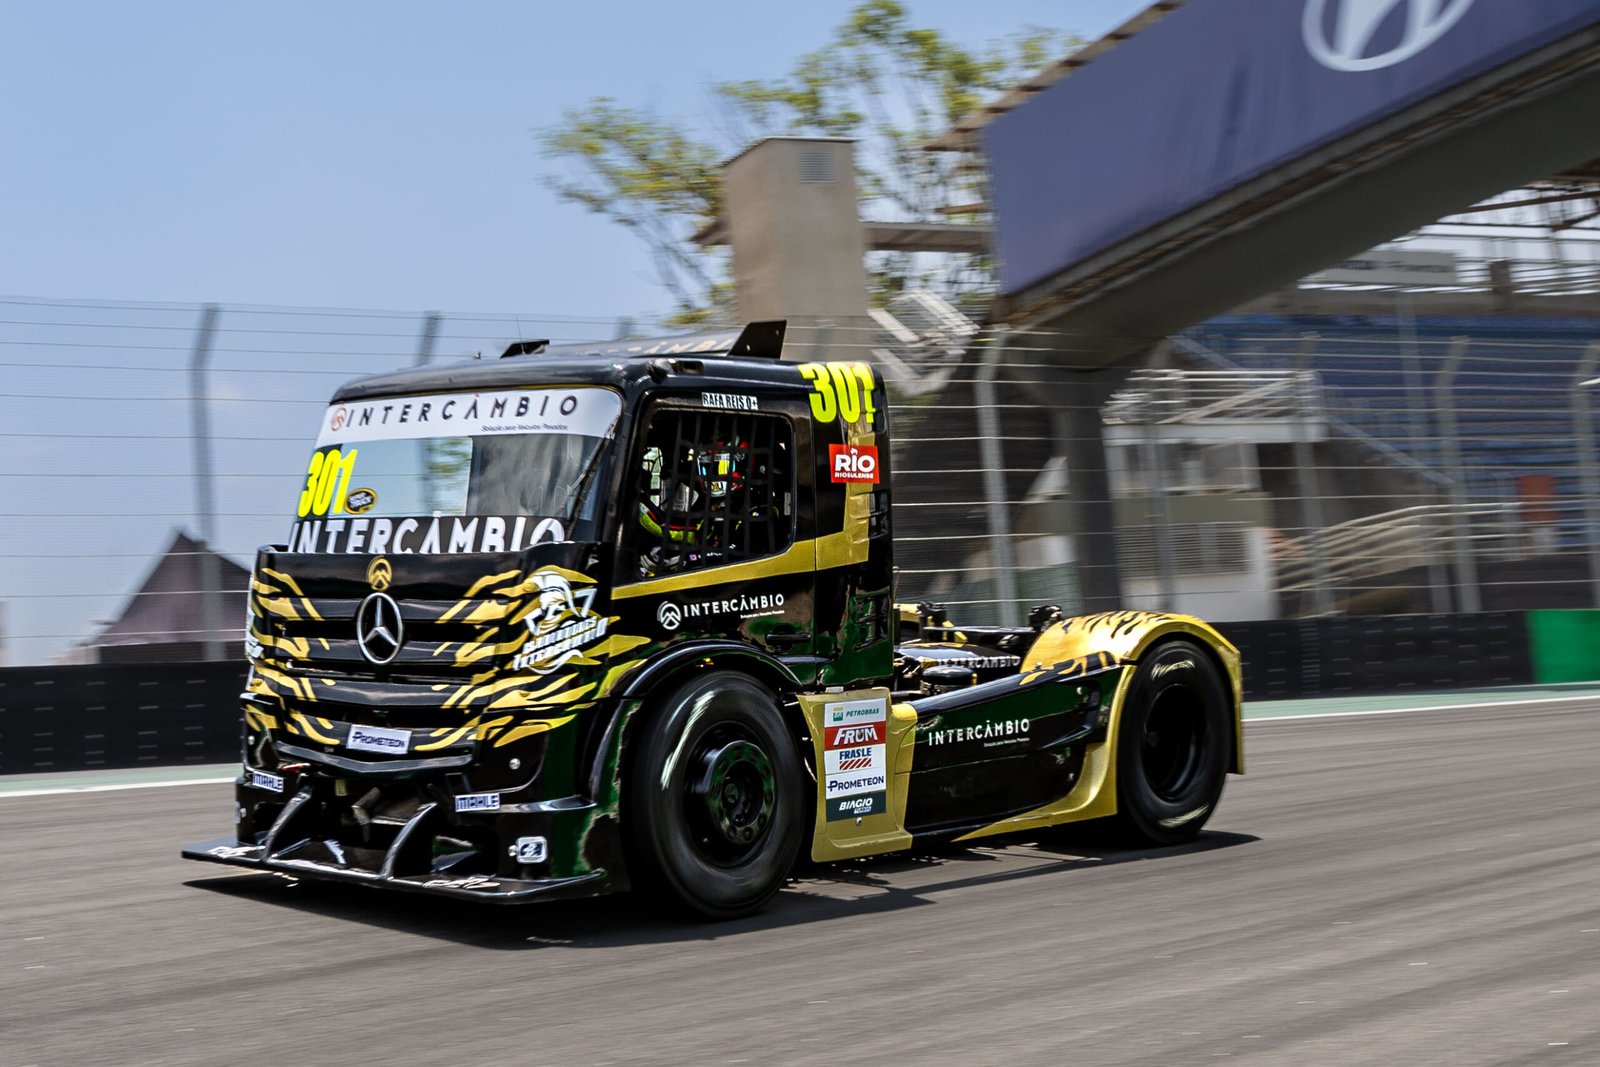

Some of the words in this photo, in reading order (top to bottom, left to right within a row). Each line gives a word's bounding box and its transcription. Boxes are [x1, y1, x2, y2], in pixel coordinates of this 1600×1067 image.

[703, 393, 724, 407] RAFA
[726, 395, 744, 409] REIS
[798, 362, 875, 423] 301
[346, 392, 577, 427] INTERCÂMBIO
[298, 449, 358, 517] 301
[684, 594, 784, 617] INTERCÂMBIO
[846, 708, 880, 717] PETROBRAS
[929, 719, 1030, 746] INTERCÂMBIO
[828, 776, 884, 791] PROMETEON
[456, 795, 499, 811] MAHLE
[839, 798, 873, 811] BIAGIO
